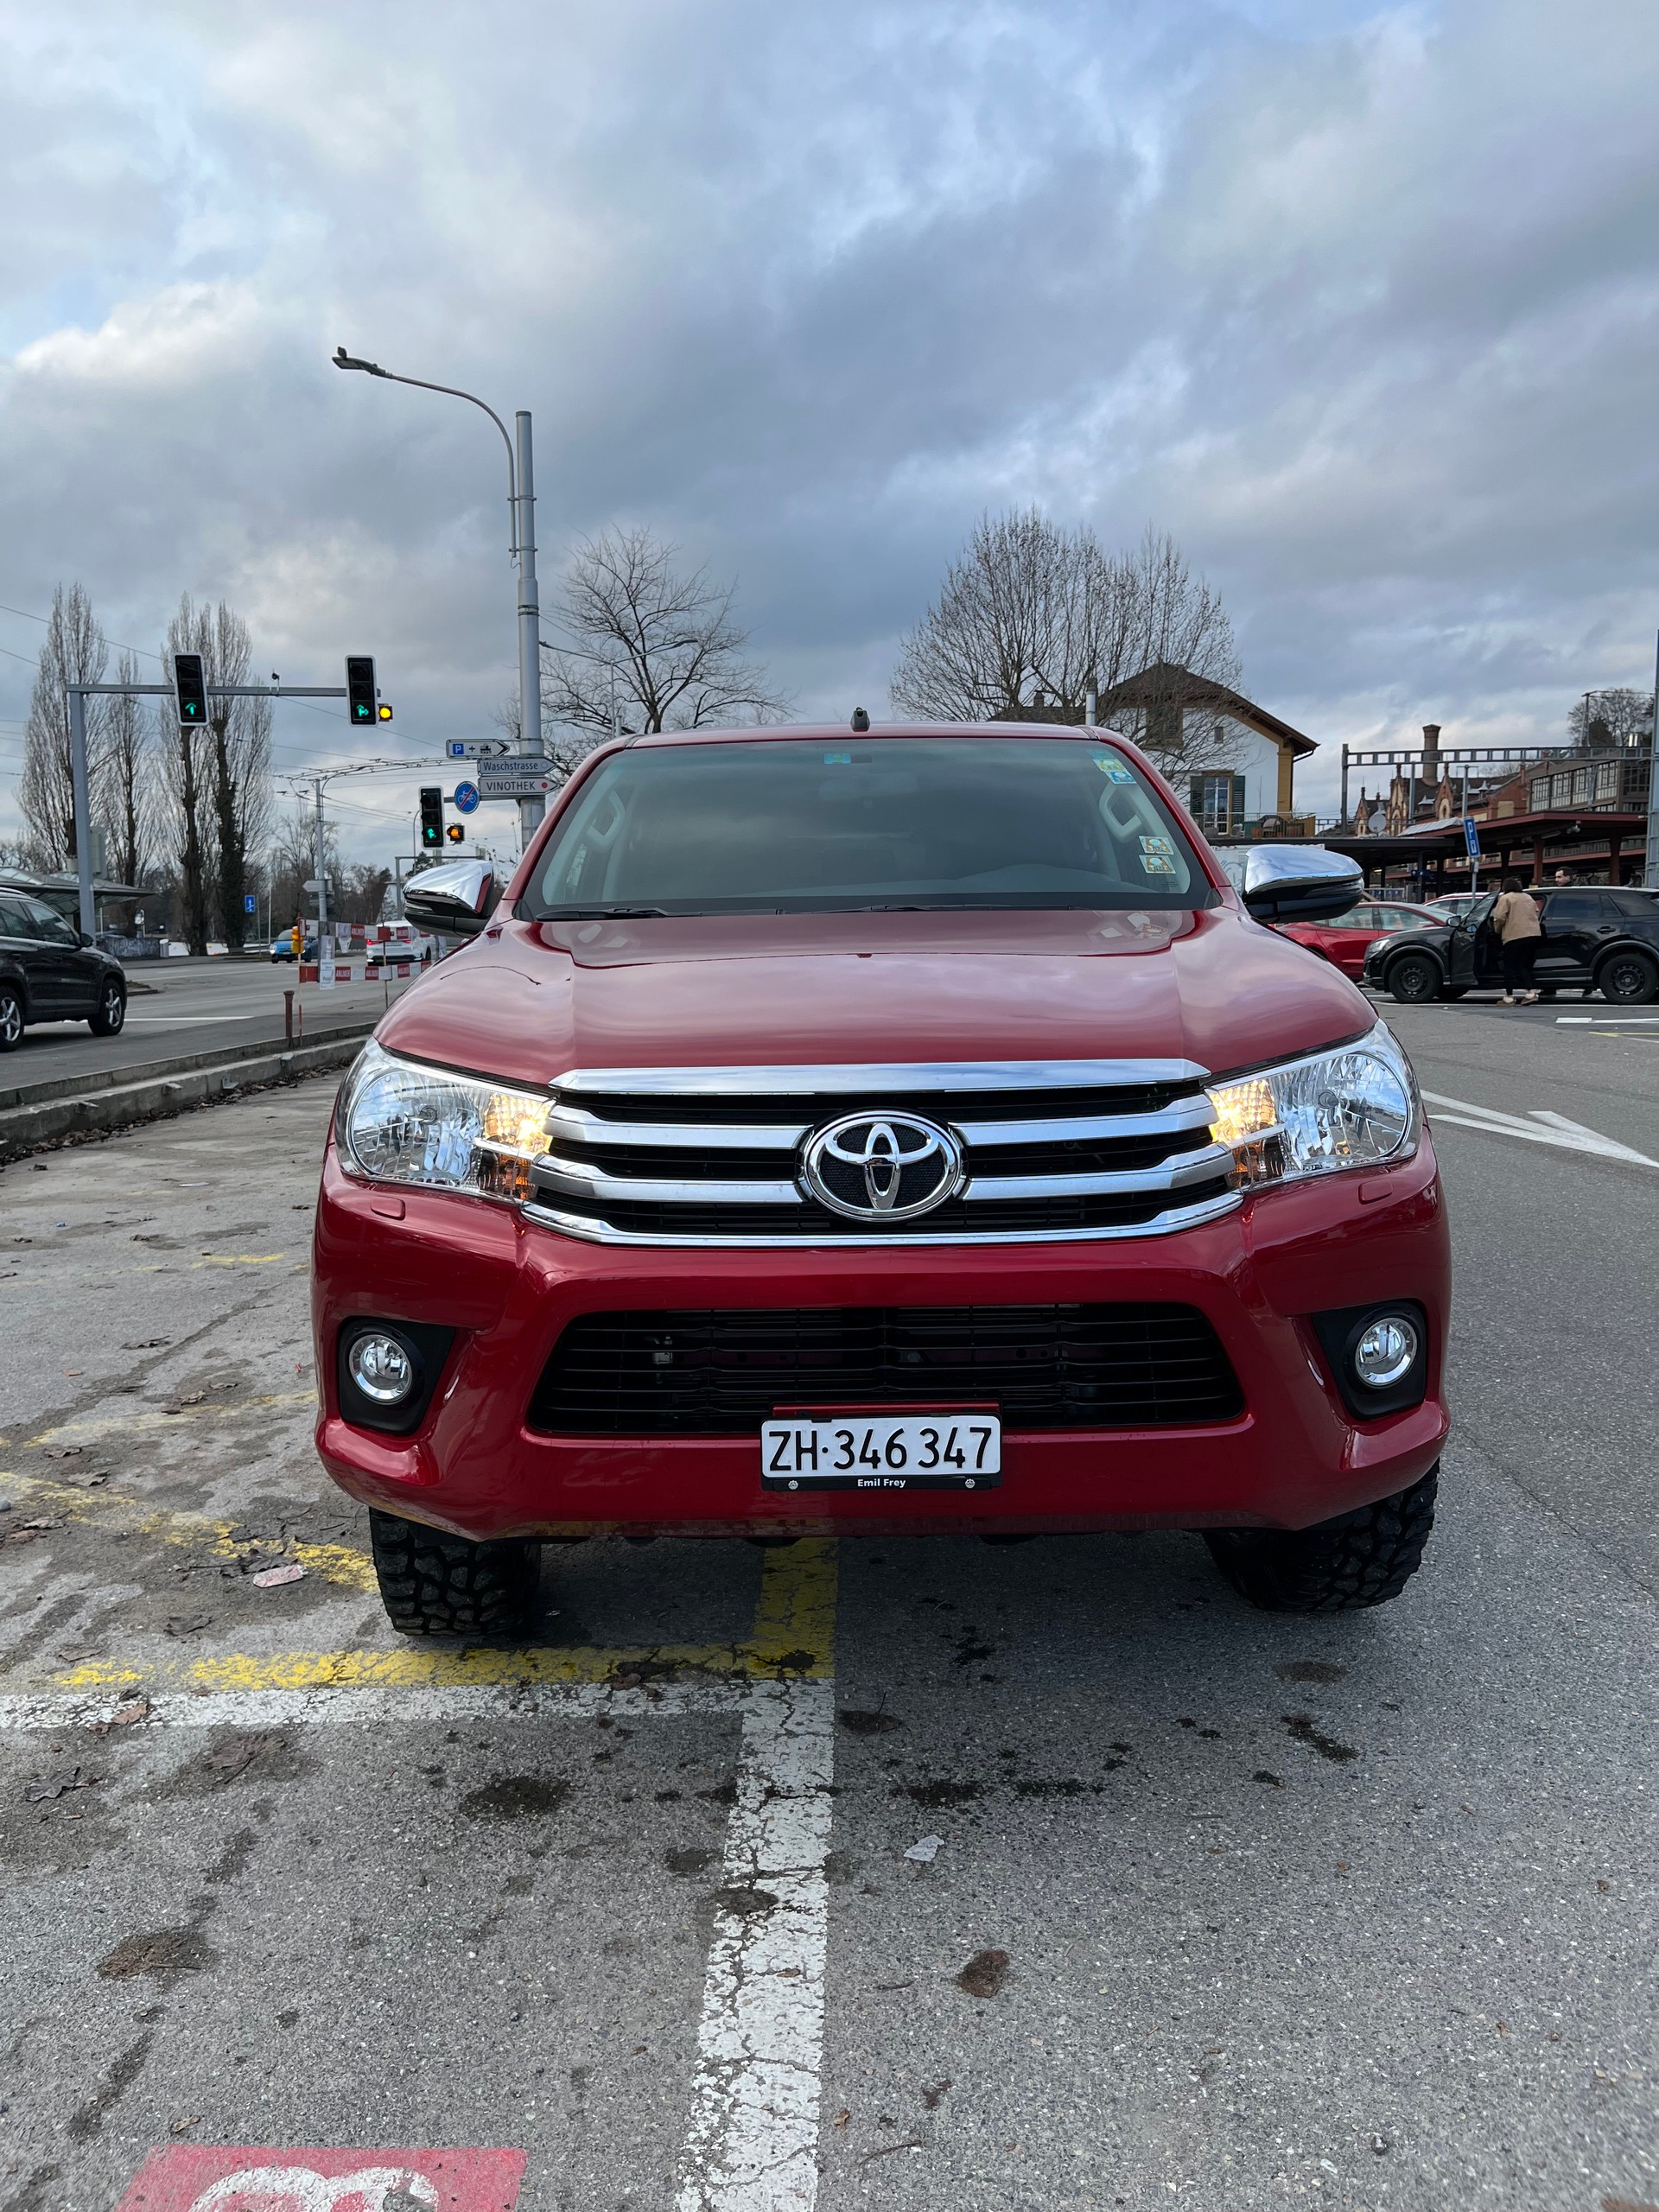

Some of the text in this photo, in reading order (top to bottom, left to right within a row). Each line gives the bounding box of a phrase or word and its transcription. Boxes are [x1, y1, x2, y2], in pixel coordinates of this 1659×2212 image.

[483, 760, 538, 771] Waschstrasse
[486, 781, 536, 791] VINOTHEK
[857, 1478, 906, 1488] Emil Frey
